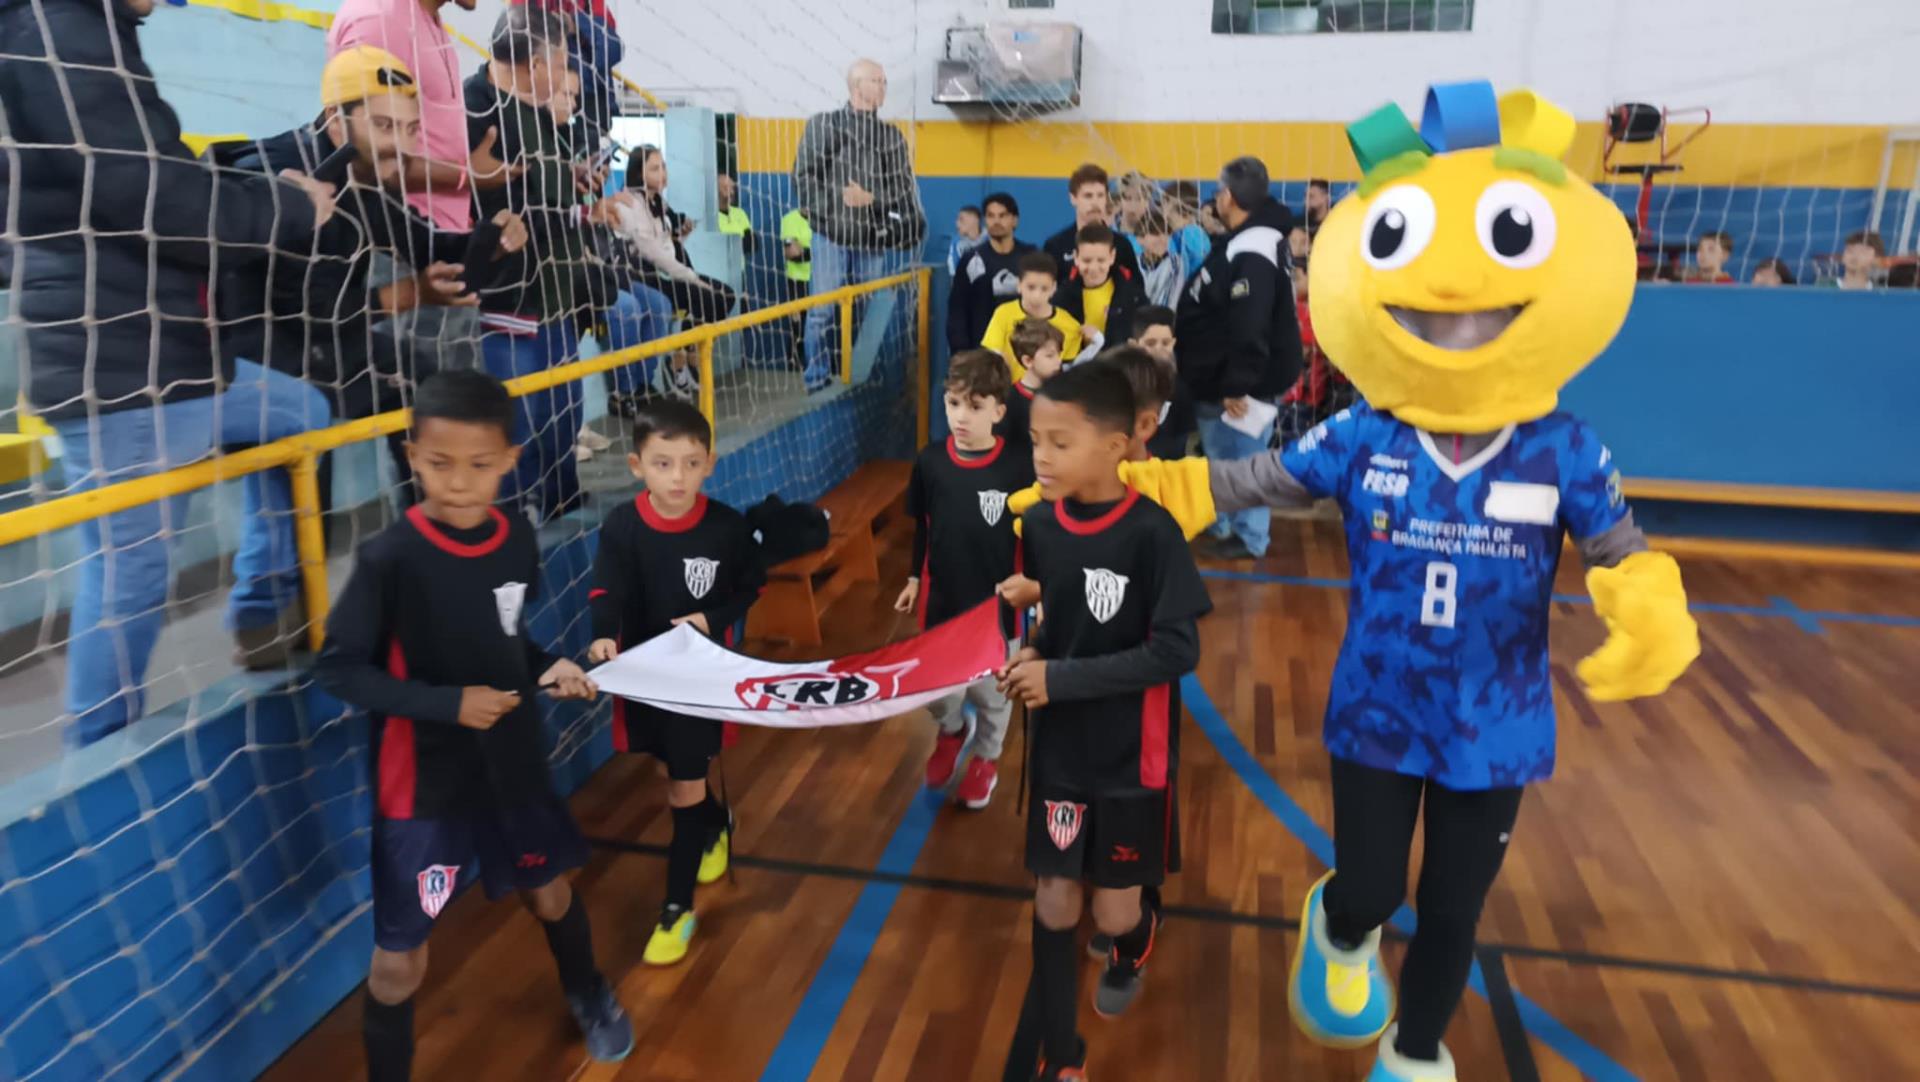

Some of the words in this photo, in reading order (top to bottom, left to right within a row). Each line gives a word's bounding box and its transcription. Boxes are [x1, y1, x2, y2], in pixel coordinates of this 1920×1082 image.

[1391, 530, 1462, 555] BRAGANÇA
[1465, 541, 1527, 559] PAULISTA
[1410, 517, 1489, 541] PREFEITURA
[1493, 527, 1513, 543] DE
[1421, 561, 1457, 629] 8
[763, 675, 869, 705] CRB
